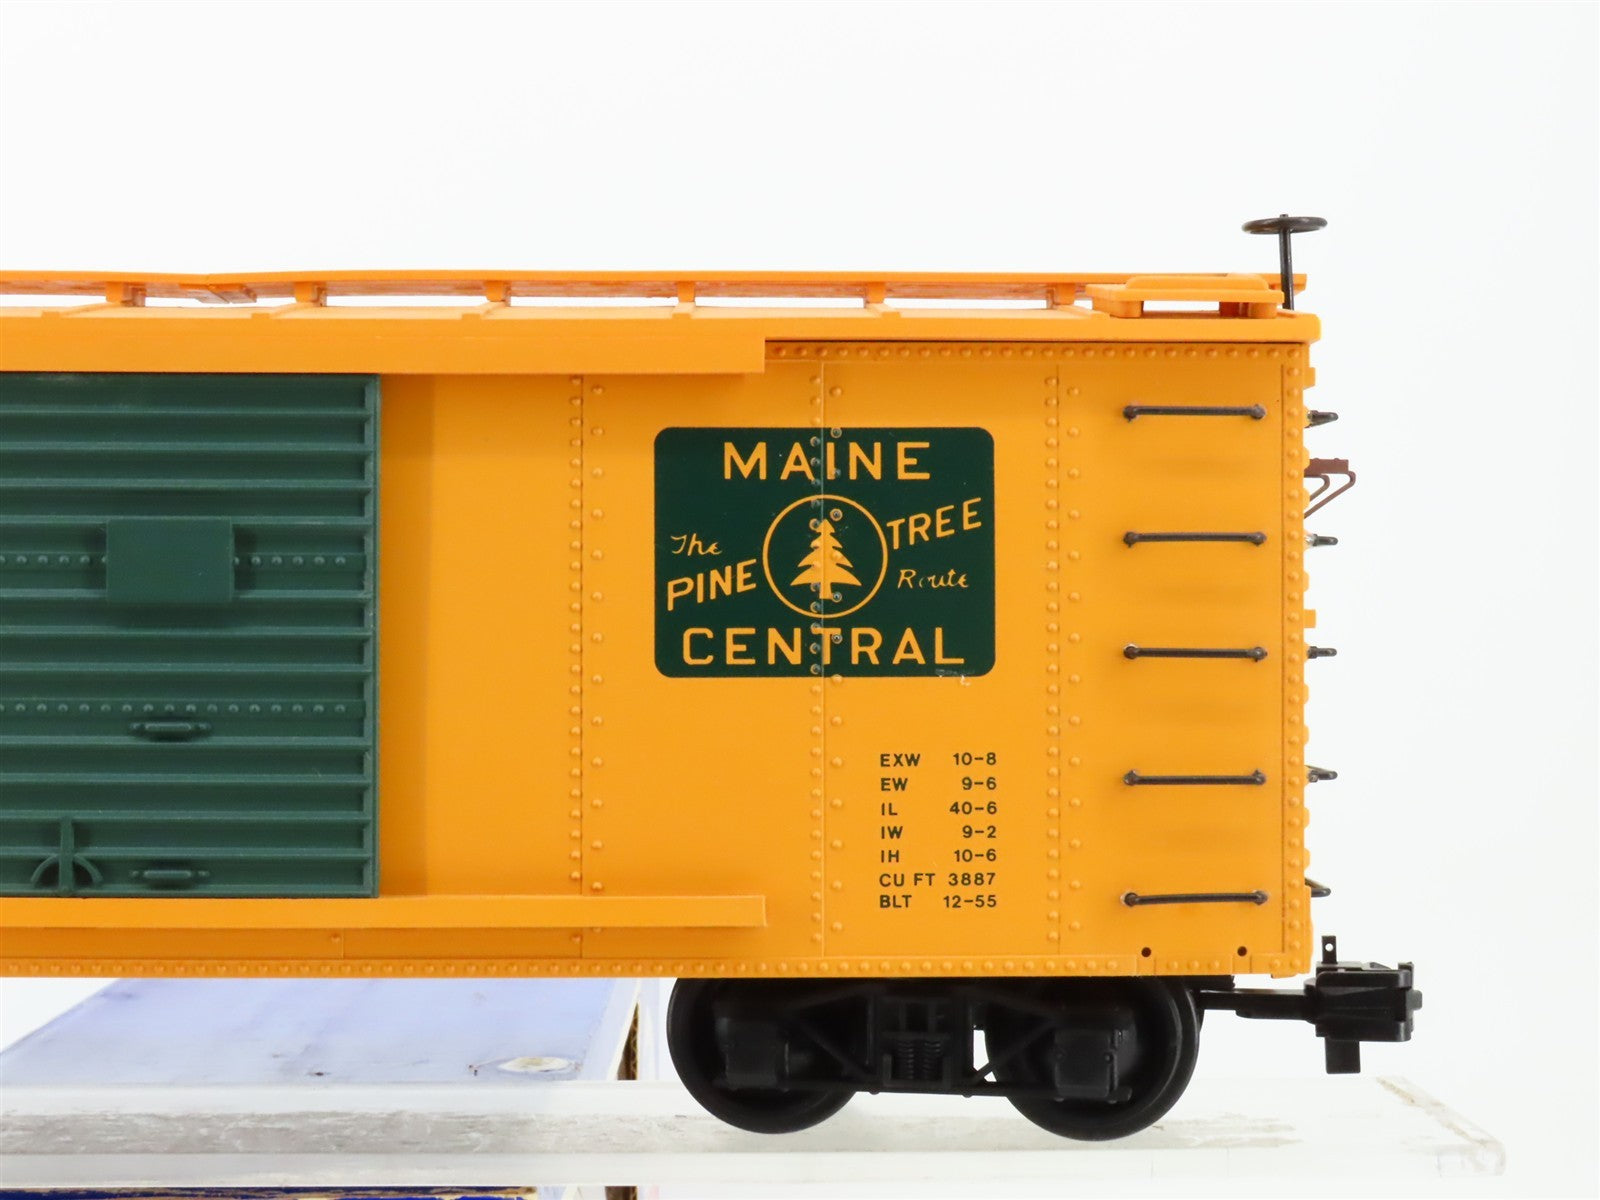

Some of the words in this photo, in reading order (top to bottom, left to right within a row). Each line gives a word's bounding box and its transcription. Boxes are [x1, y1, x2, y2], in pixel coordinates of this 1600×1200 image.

[723, 441, 931, 481] MAINE
[670, 533, 722, 556] The
[666, 558, 757, 611] PINE
[886, 497, 982, 550] TREE
[682, 627, 965, 666] CENTRAL
[880, 753, 921, 767] EXW
[953, 752, 997, 766] 10-8
[880, 777, 908, 791] EW
[961, 776, 997, 791] 9-6
[881, 802, 898, 816] IL
[949, 801, 997, 815] 40-6
[881, 826, 903, 839] IW
[962, 825, 997, 839] 9-2
[881, 850, 900, 863] IH
[954, 848, 997, 862] 10-6
[879, 873, 905, 887] CU
[913, 873, 936, 886] FT
[948, 872, 996, 886] 3887
[879, 894, 912, 908] BLT
[943, 894, 997, 908] 12-55
